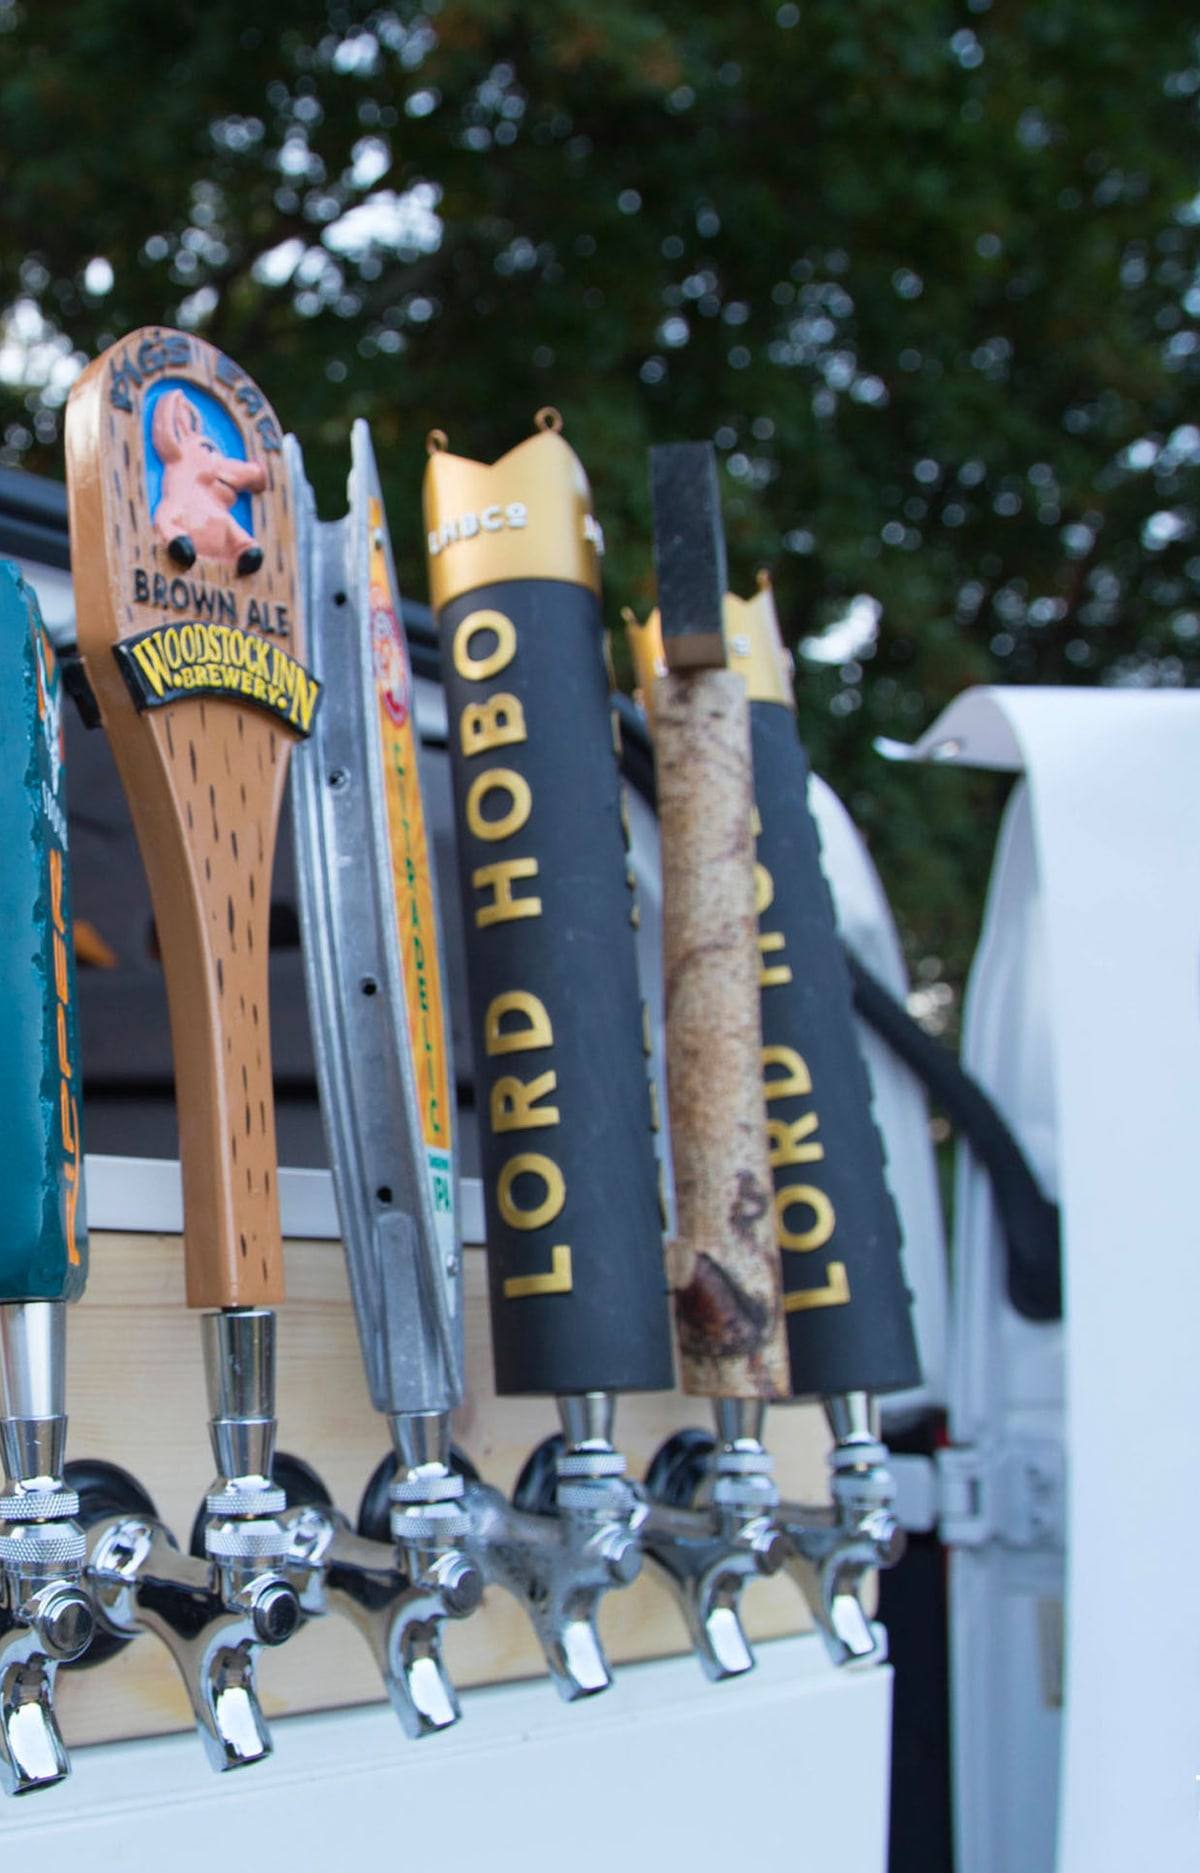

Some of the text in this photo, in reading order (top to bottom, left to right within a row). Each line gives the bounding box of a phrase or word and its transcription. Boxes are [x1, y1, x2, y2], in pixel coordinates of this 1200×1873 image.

[133, 623, 270, 697] WOODSTOCK
[271, 647, 319, 732] INN
[134, 568, 289, 637] BROWN ALE
[452, 609, 573, 1298] LORD HOBO
[761, 1045, 851, 1313] LORD
